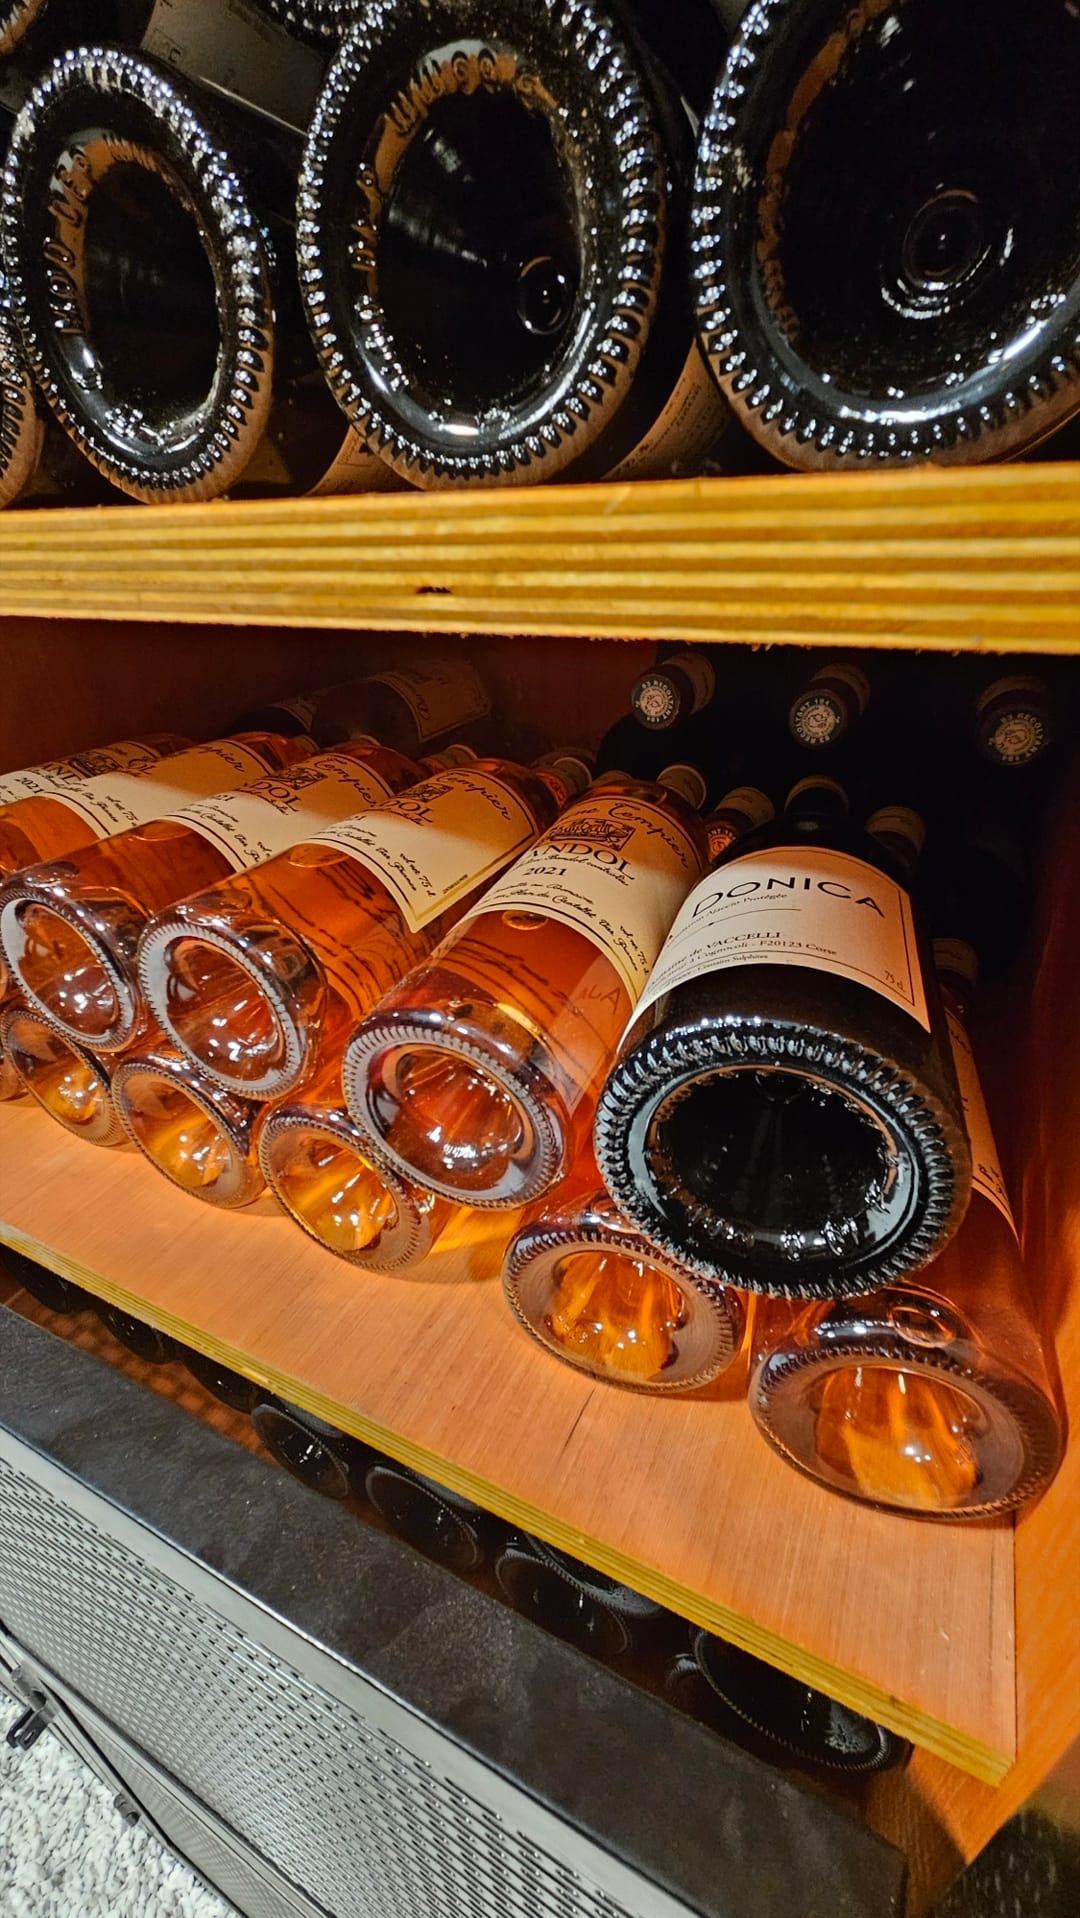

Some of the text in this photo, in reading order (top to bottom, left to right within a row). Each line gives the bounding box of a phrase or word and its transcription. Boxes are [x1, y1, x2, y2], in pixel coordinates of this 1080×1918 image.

[435, 771, 512, 821] Tempier
[607, 802, 689, 870] Tempier
[521, 865, 568, 877] 2021
[691, 875, 886, 919] DONICA
[706, 931, 782, 951] VACCELLI
[759, 940, 803, 950] F20123
[805, 943, 838, 956] Corse
